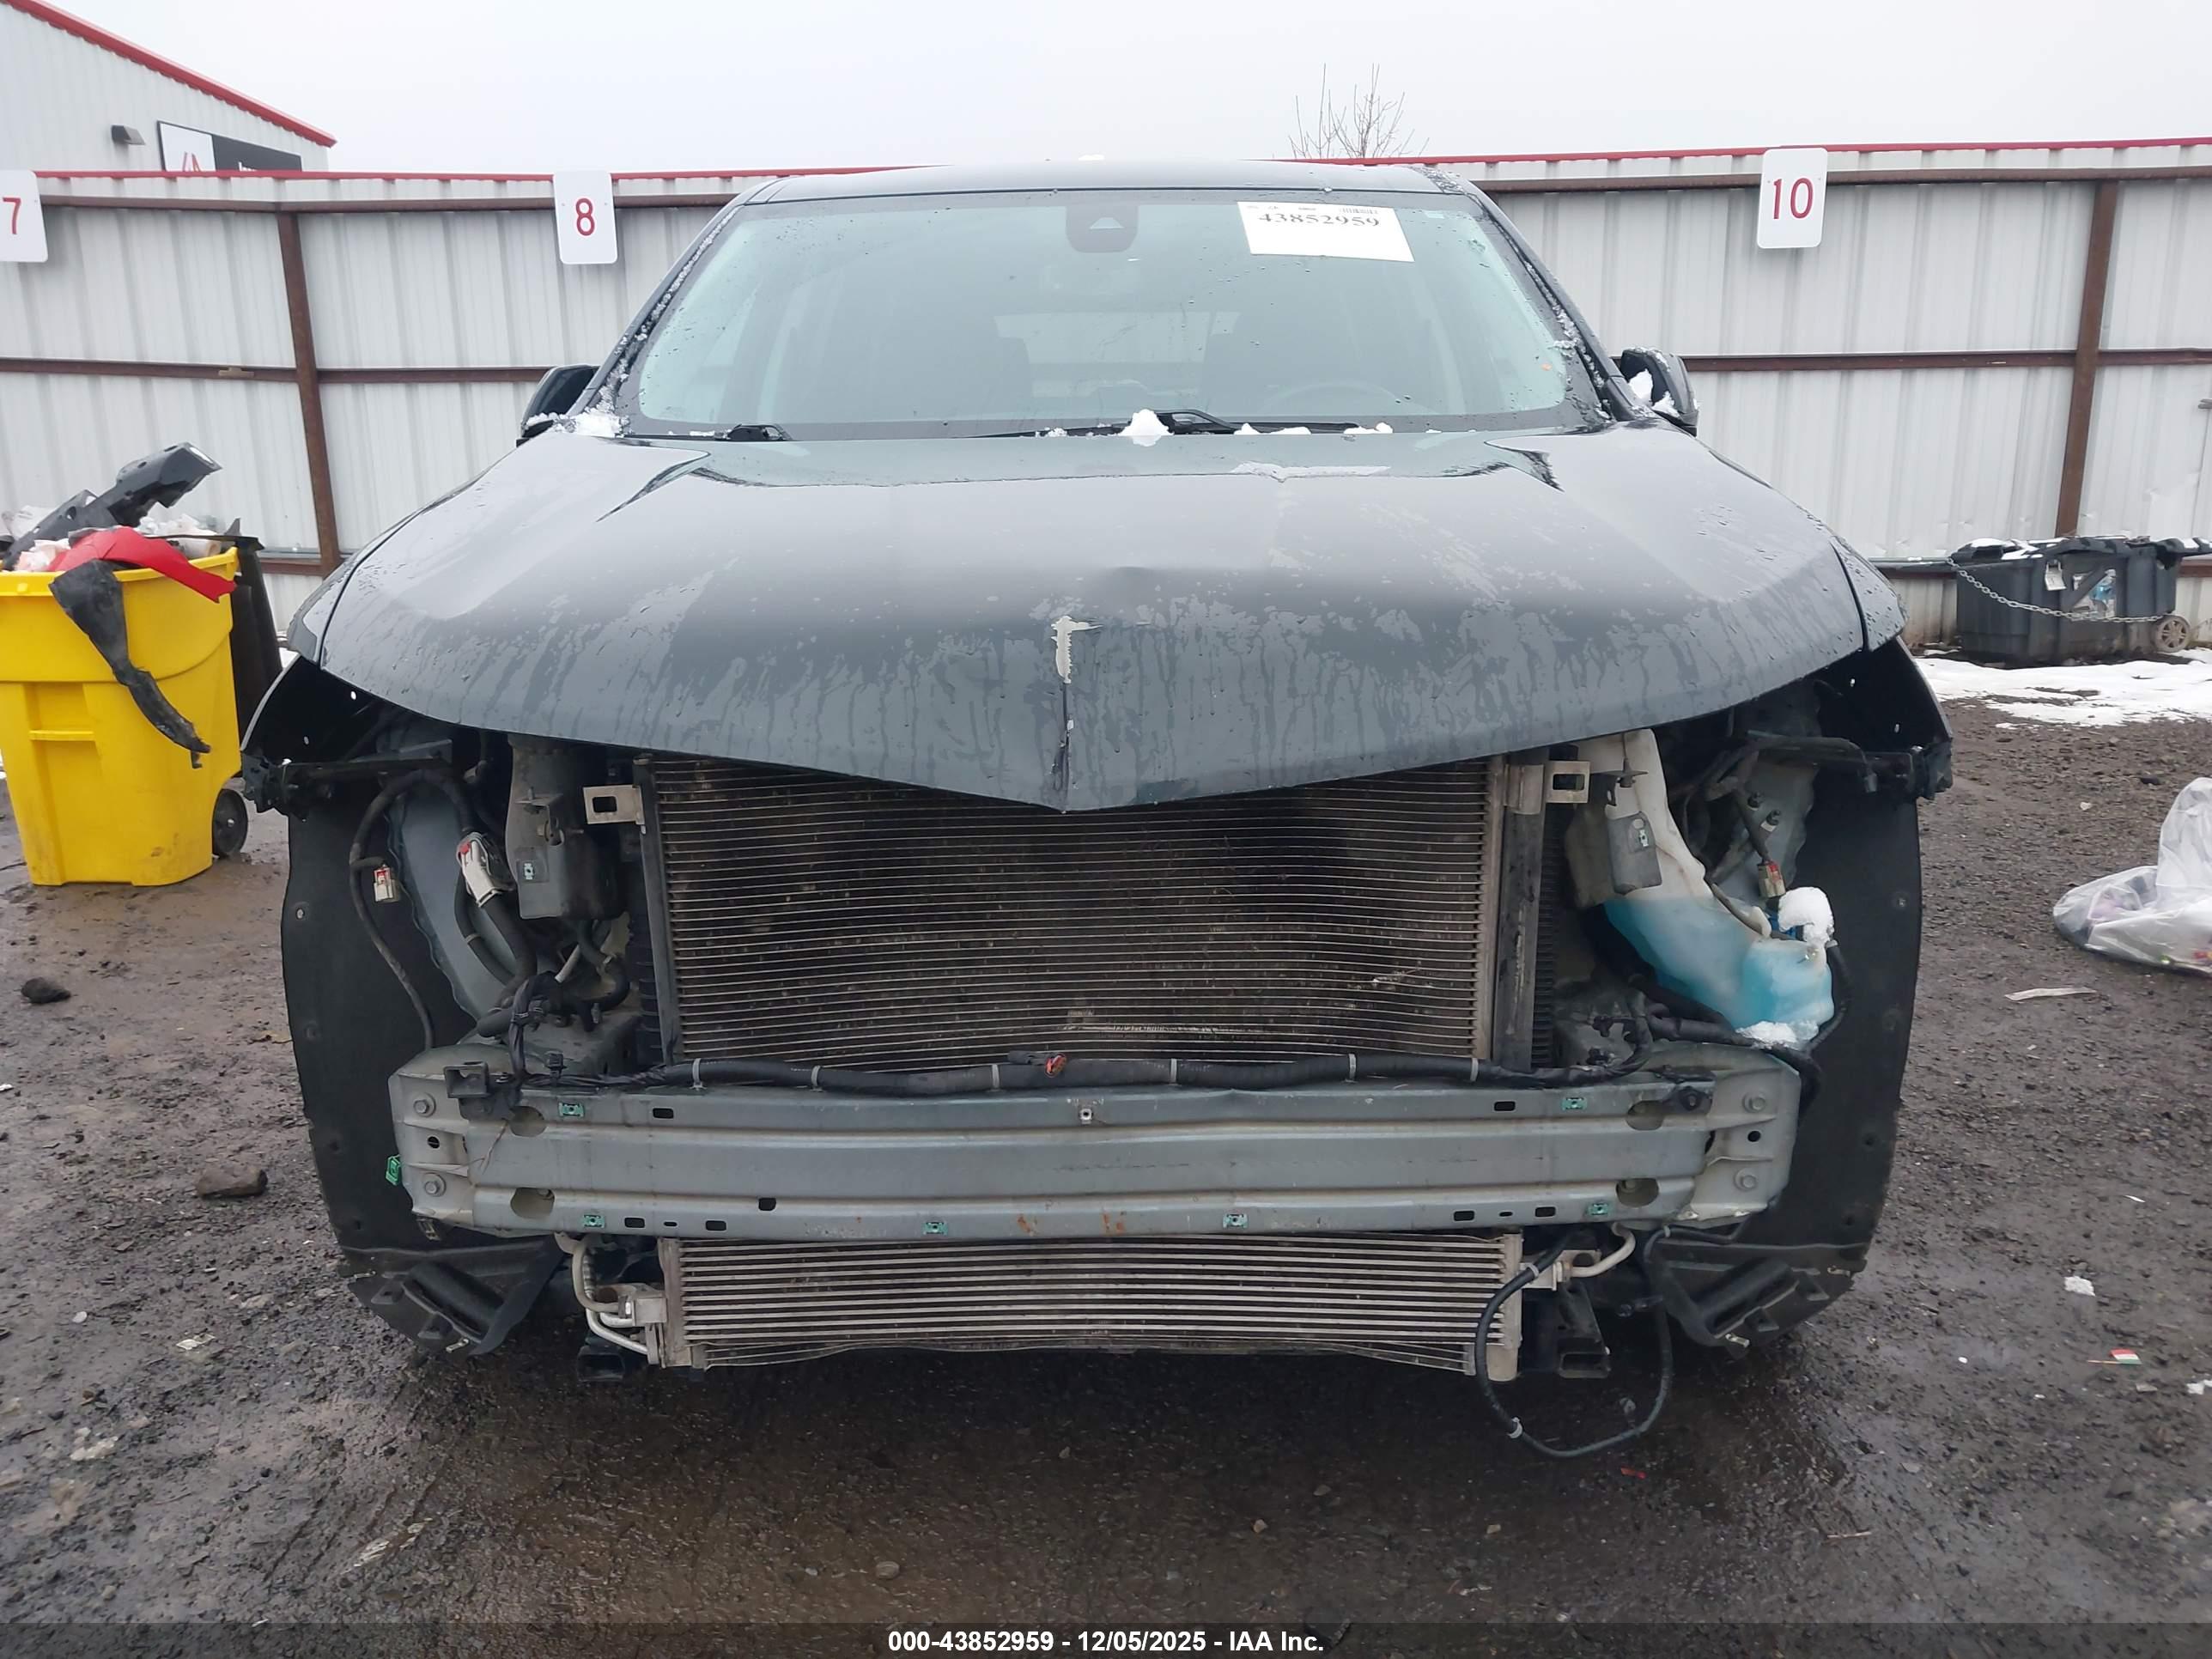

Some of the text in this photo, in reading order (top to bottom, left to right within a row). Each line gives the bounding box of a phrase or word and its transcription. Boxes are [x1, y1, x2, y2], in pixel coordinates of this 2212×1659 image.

[3, 198, 21, 235] 7
[575, 198, 595, 236] 8
[1773, 177, 1814, 220] 10
[1259, 212, 1380, 227] 43852959
